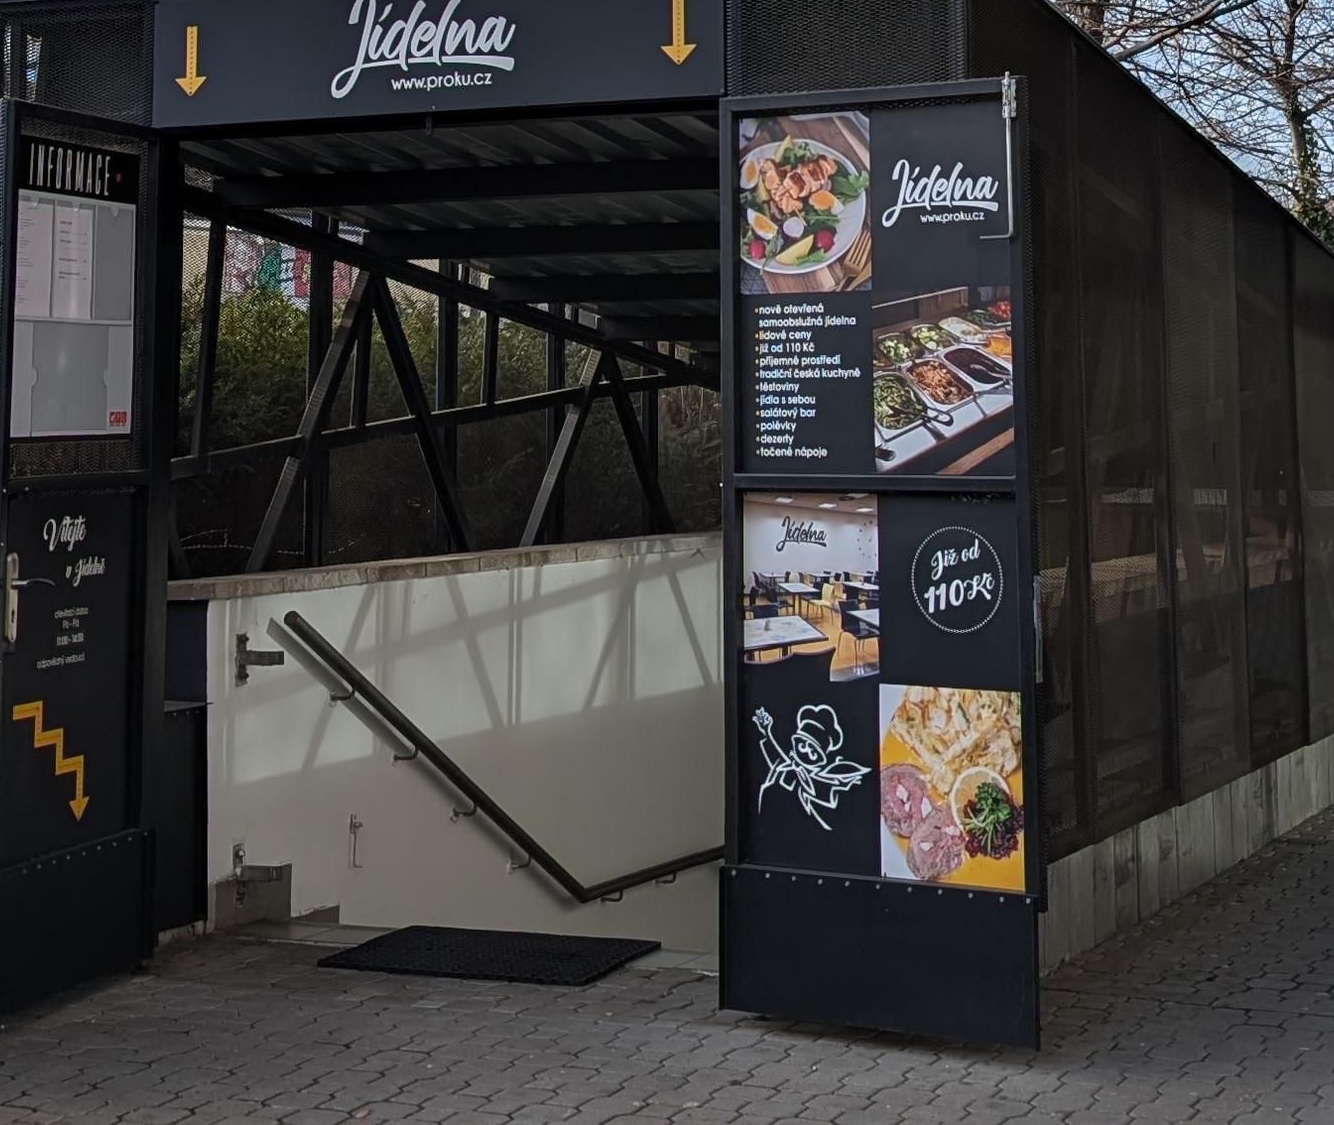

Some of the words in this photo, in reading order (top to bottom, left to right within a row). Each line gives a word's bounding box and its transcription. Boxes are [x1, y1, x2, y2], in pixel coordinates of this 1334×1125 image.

[391, 72, 492, 91] www.proku.cz
[29, 143, 111, 196] INFORMACE
[882, 159, 999, 228] Jídelna
[920, 211, 985, 223] www.proku.cz
[783, 302, 824, 314] otevřená
[759, 316, 823, 328] samoobslužná
[824, 315, 857, 328] jídelna
[759, 329, 786, 340] lidové
[788, 331, 812, 340] ceny
[770, 343, 783, 353] od
[785, 342, 801, 353] 110
[802, 342, 815, 352] Kč
[759, 355, 799, 368] příjemné
[801, 354, 841, 367] prostředí
[759, 368, 792, 379] tradiční
[793, 367, 821, 379] česká
[822, 367, 861, 379] kuchyně
[759, 381, 800, 393] těstoviny
[788, 394, 816, 404] sebou
[760, 407, 798, 419] salátový
[800, 408, 816, 417] bar
[760, 420, 797, 432] polévky
[760, 433, 794, 445] dezerty
[760, 446, 793, 457] točené
[795, 446, 828, 459] nápoje
[776, 515, 827, 552] Jídelna
[930, 548, 959, 581] Již
[961, 538, 981, 562] od
